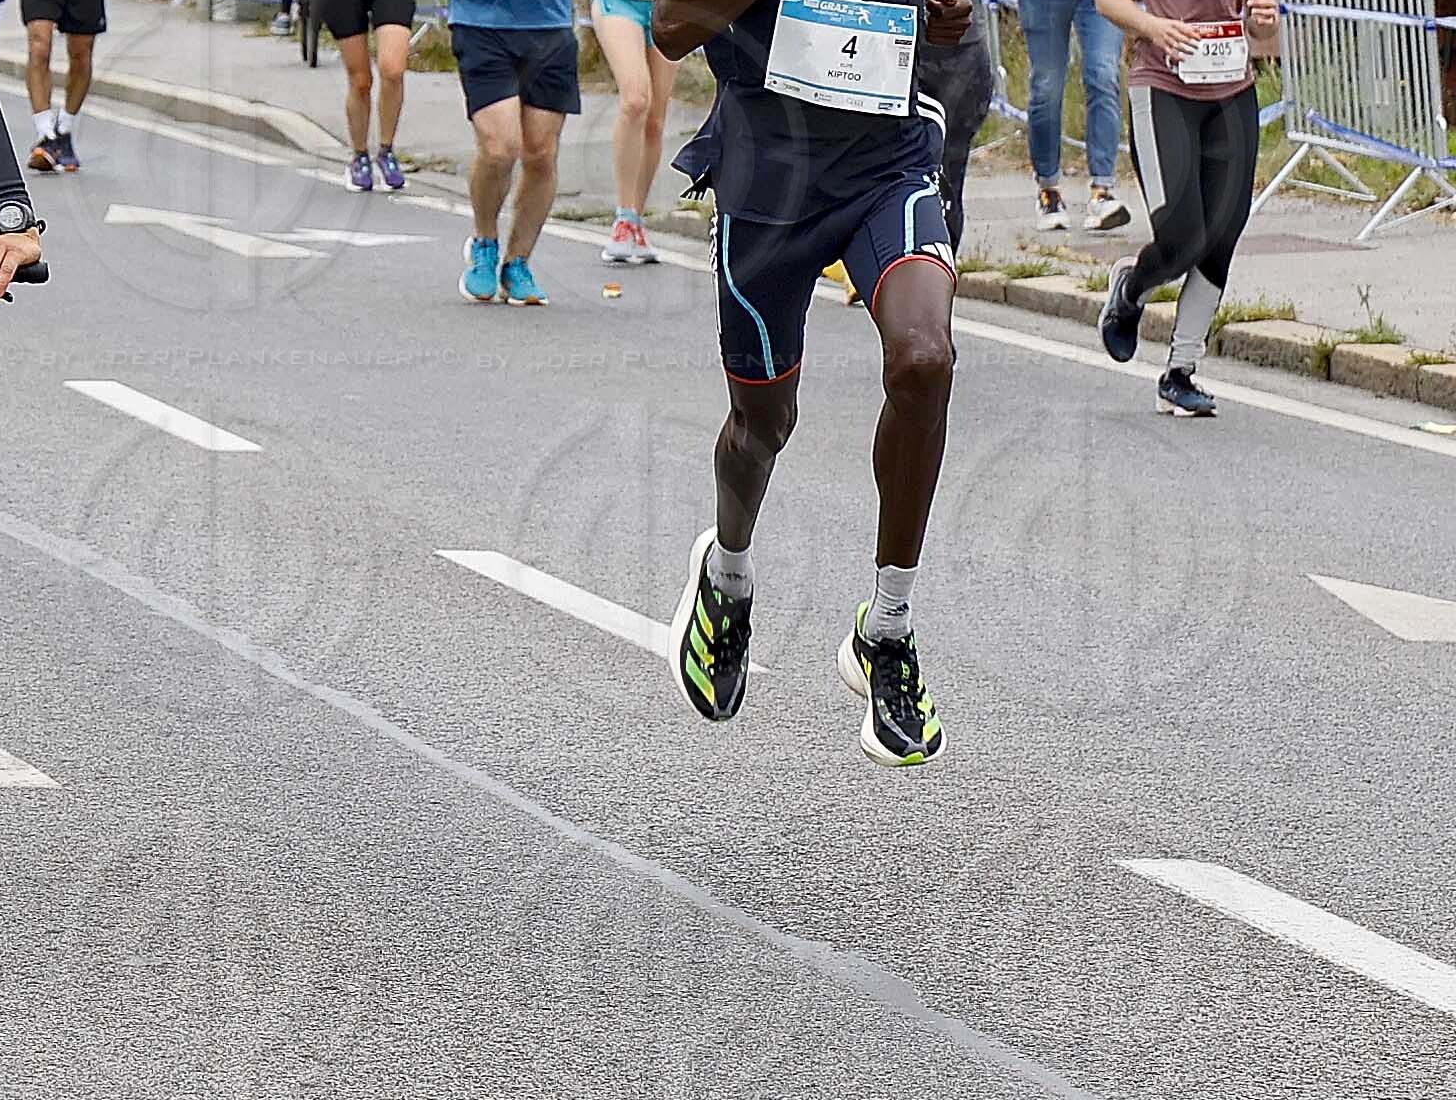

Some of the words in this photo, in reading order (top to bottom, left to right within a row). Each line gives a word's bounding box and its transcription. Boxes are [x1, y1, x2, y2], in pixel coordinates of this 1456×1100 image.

[820, 1, 849, 13] GRAZ
[841, 35, 858, 59] 4
[1202, 42, 1232, 56] 3205
[827, 69, 862, 82] KIPTOO
